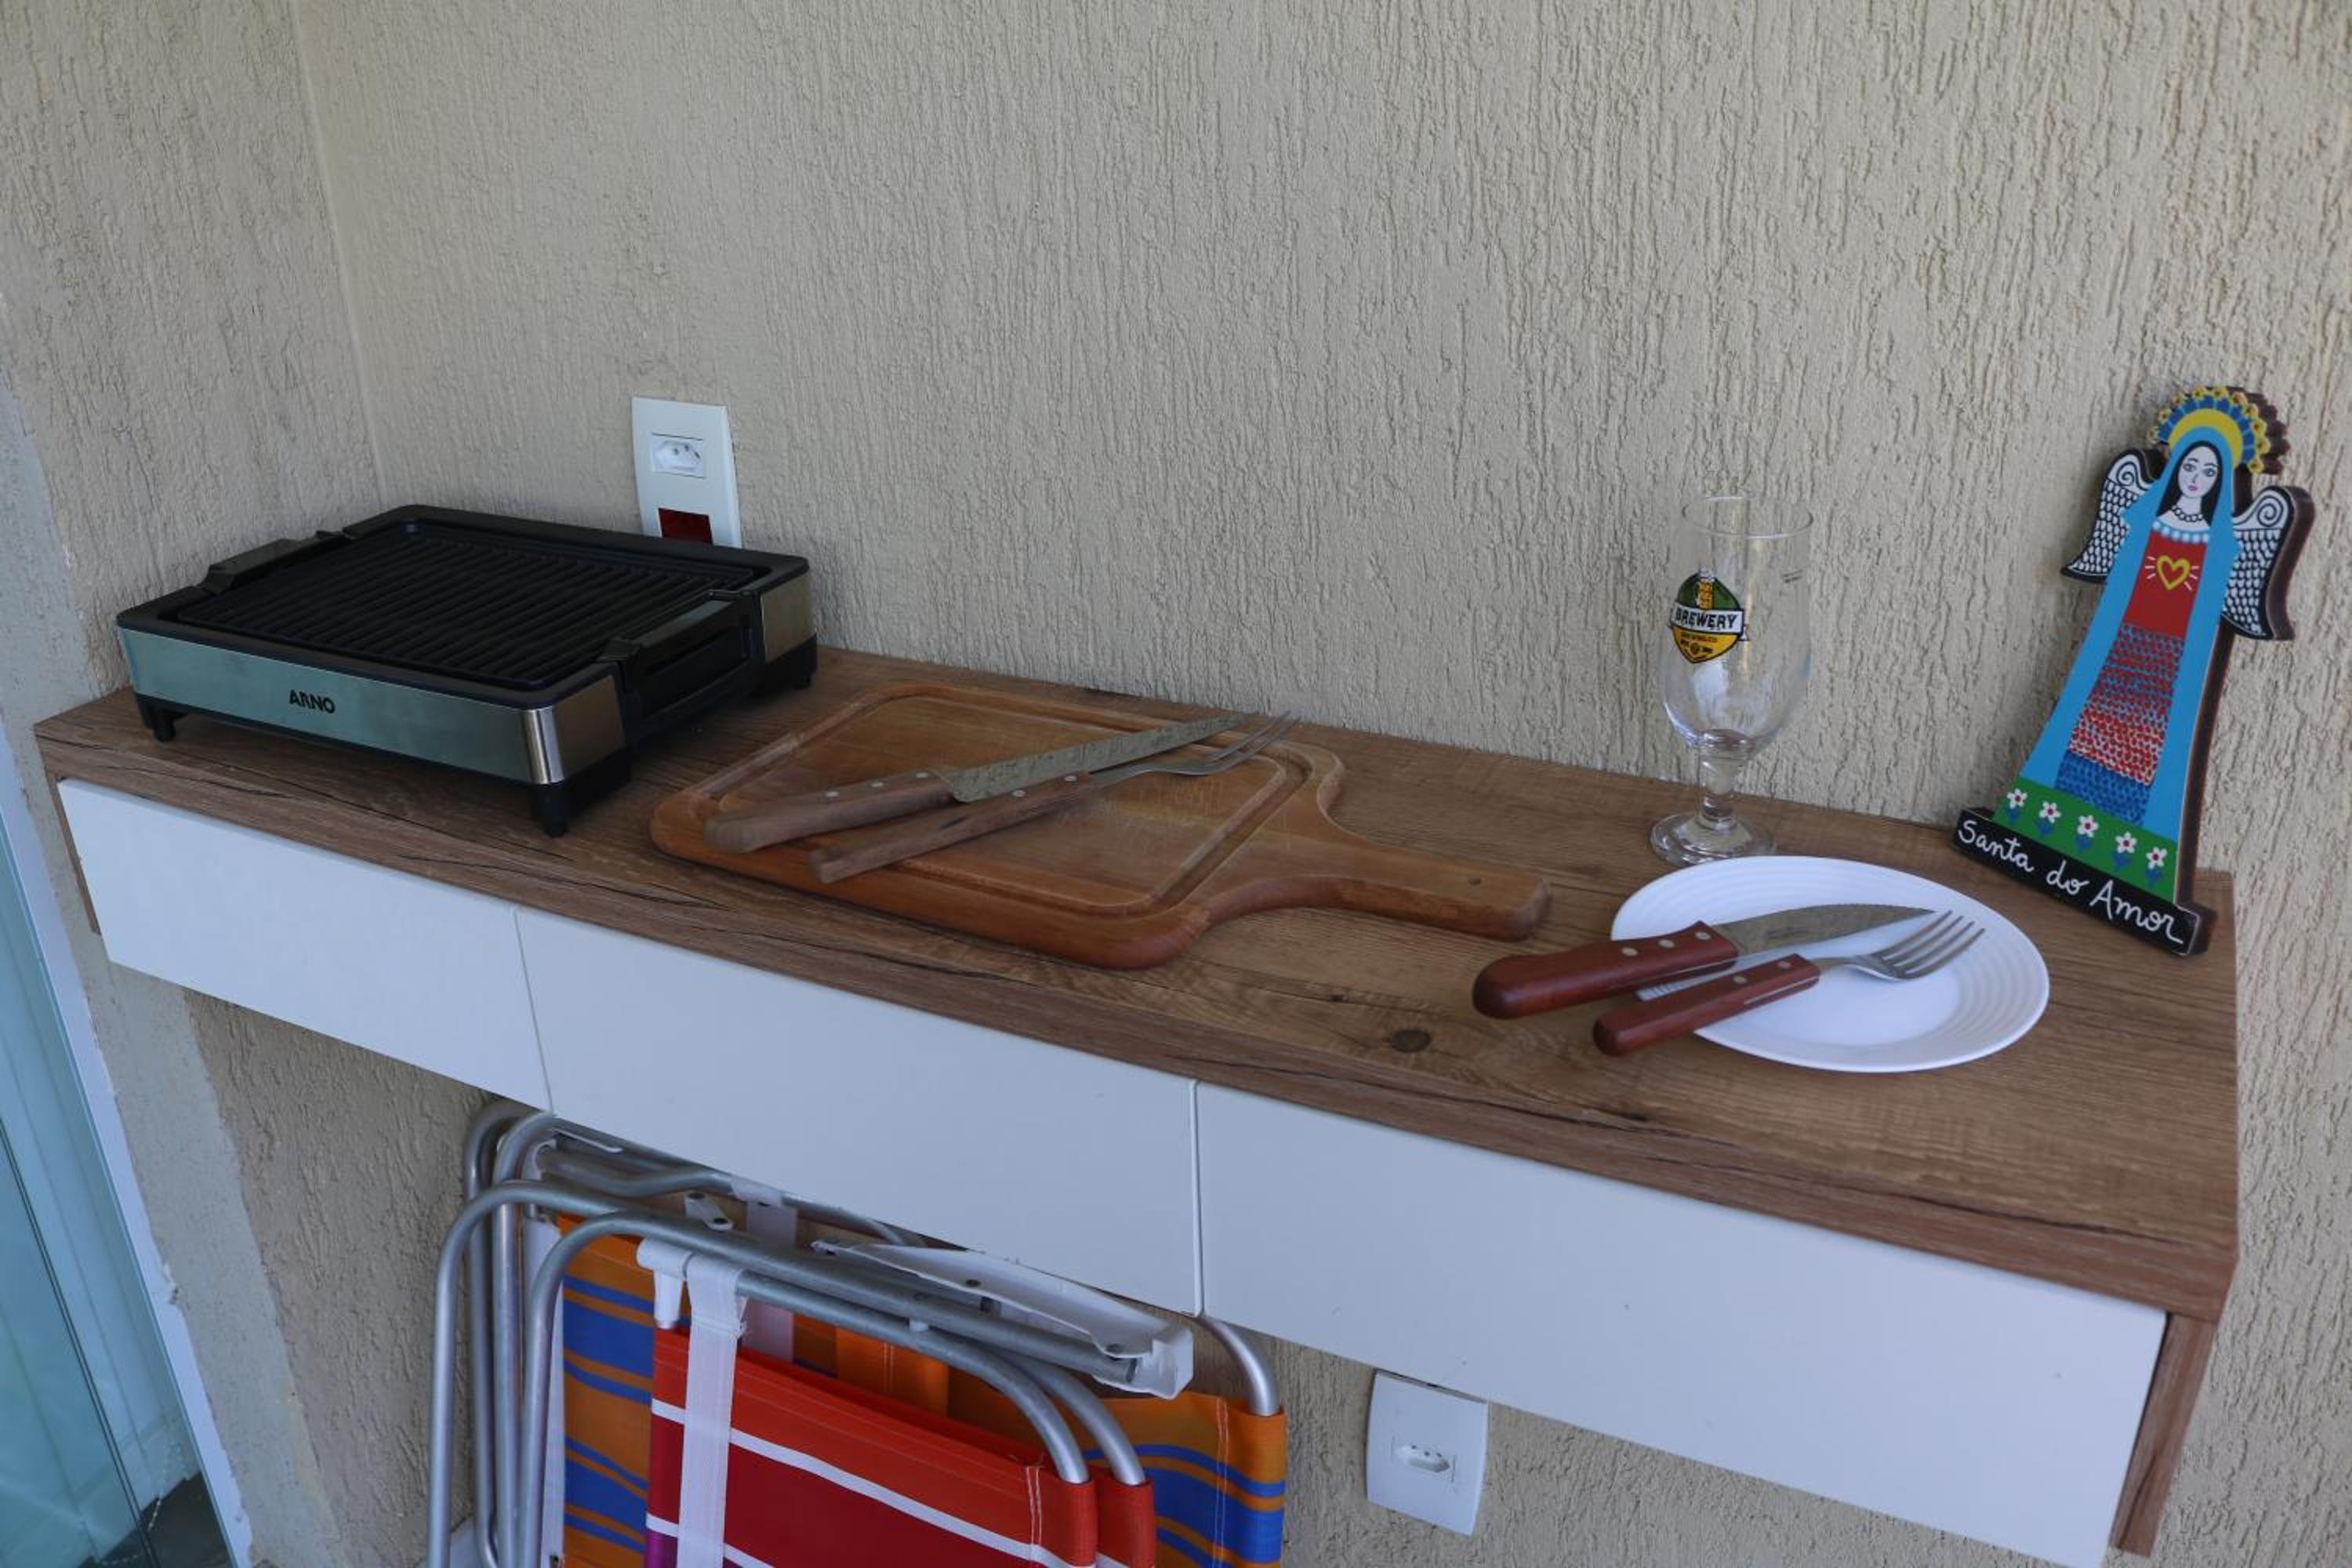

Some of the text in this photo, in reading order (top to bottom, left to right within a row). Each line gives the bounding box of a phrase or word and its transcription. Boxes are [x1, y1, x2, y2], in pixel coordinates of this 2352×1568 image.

[1675, 607, 1739, 629] BREWERY
[289, 689, 336, 714] ARNO
[1958, 820, 2183, 945] Santa do Amor
